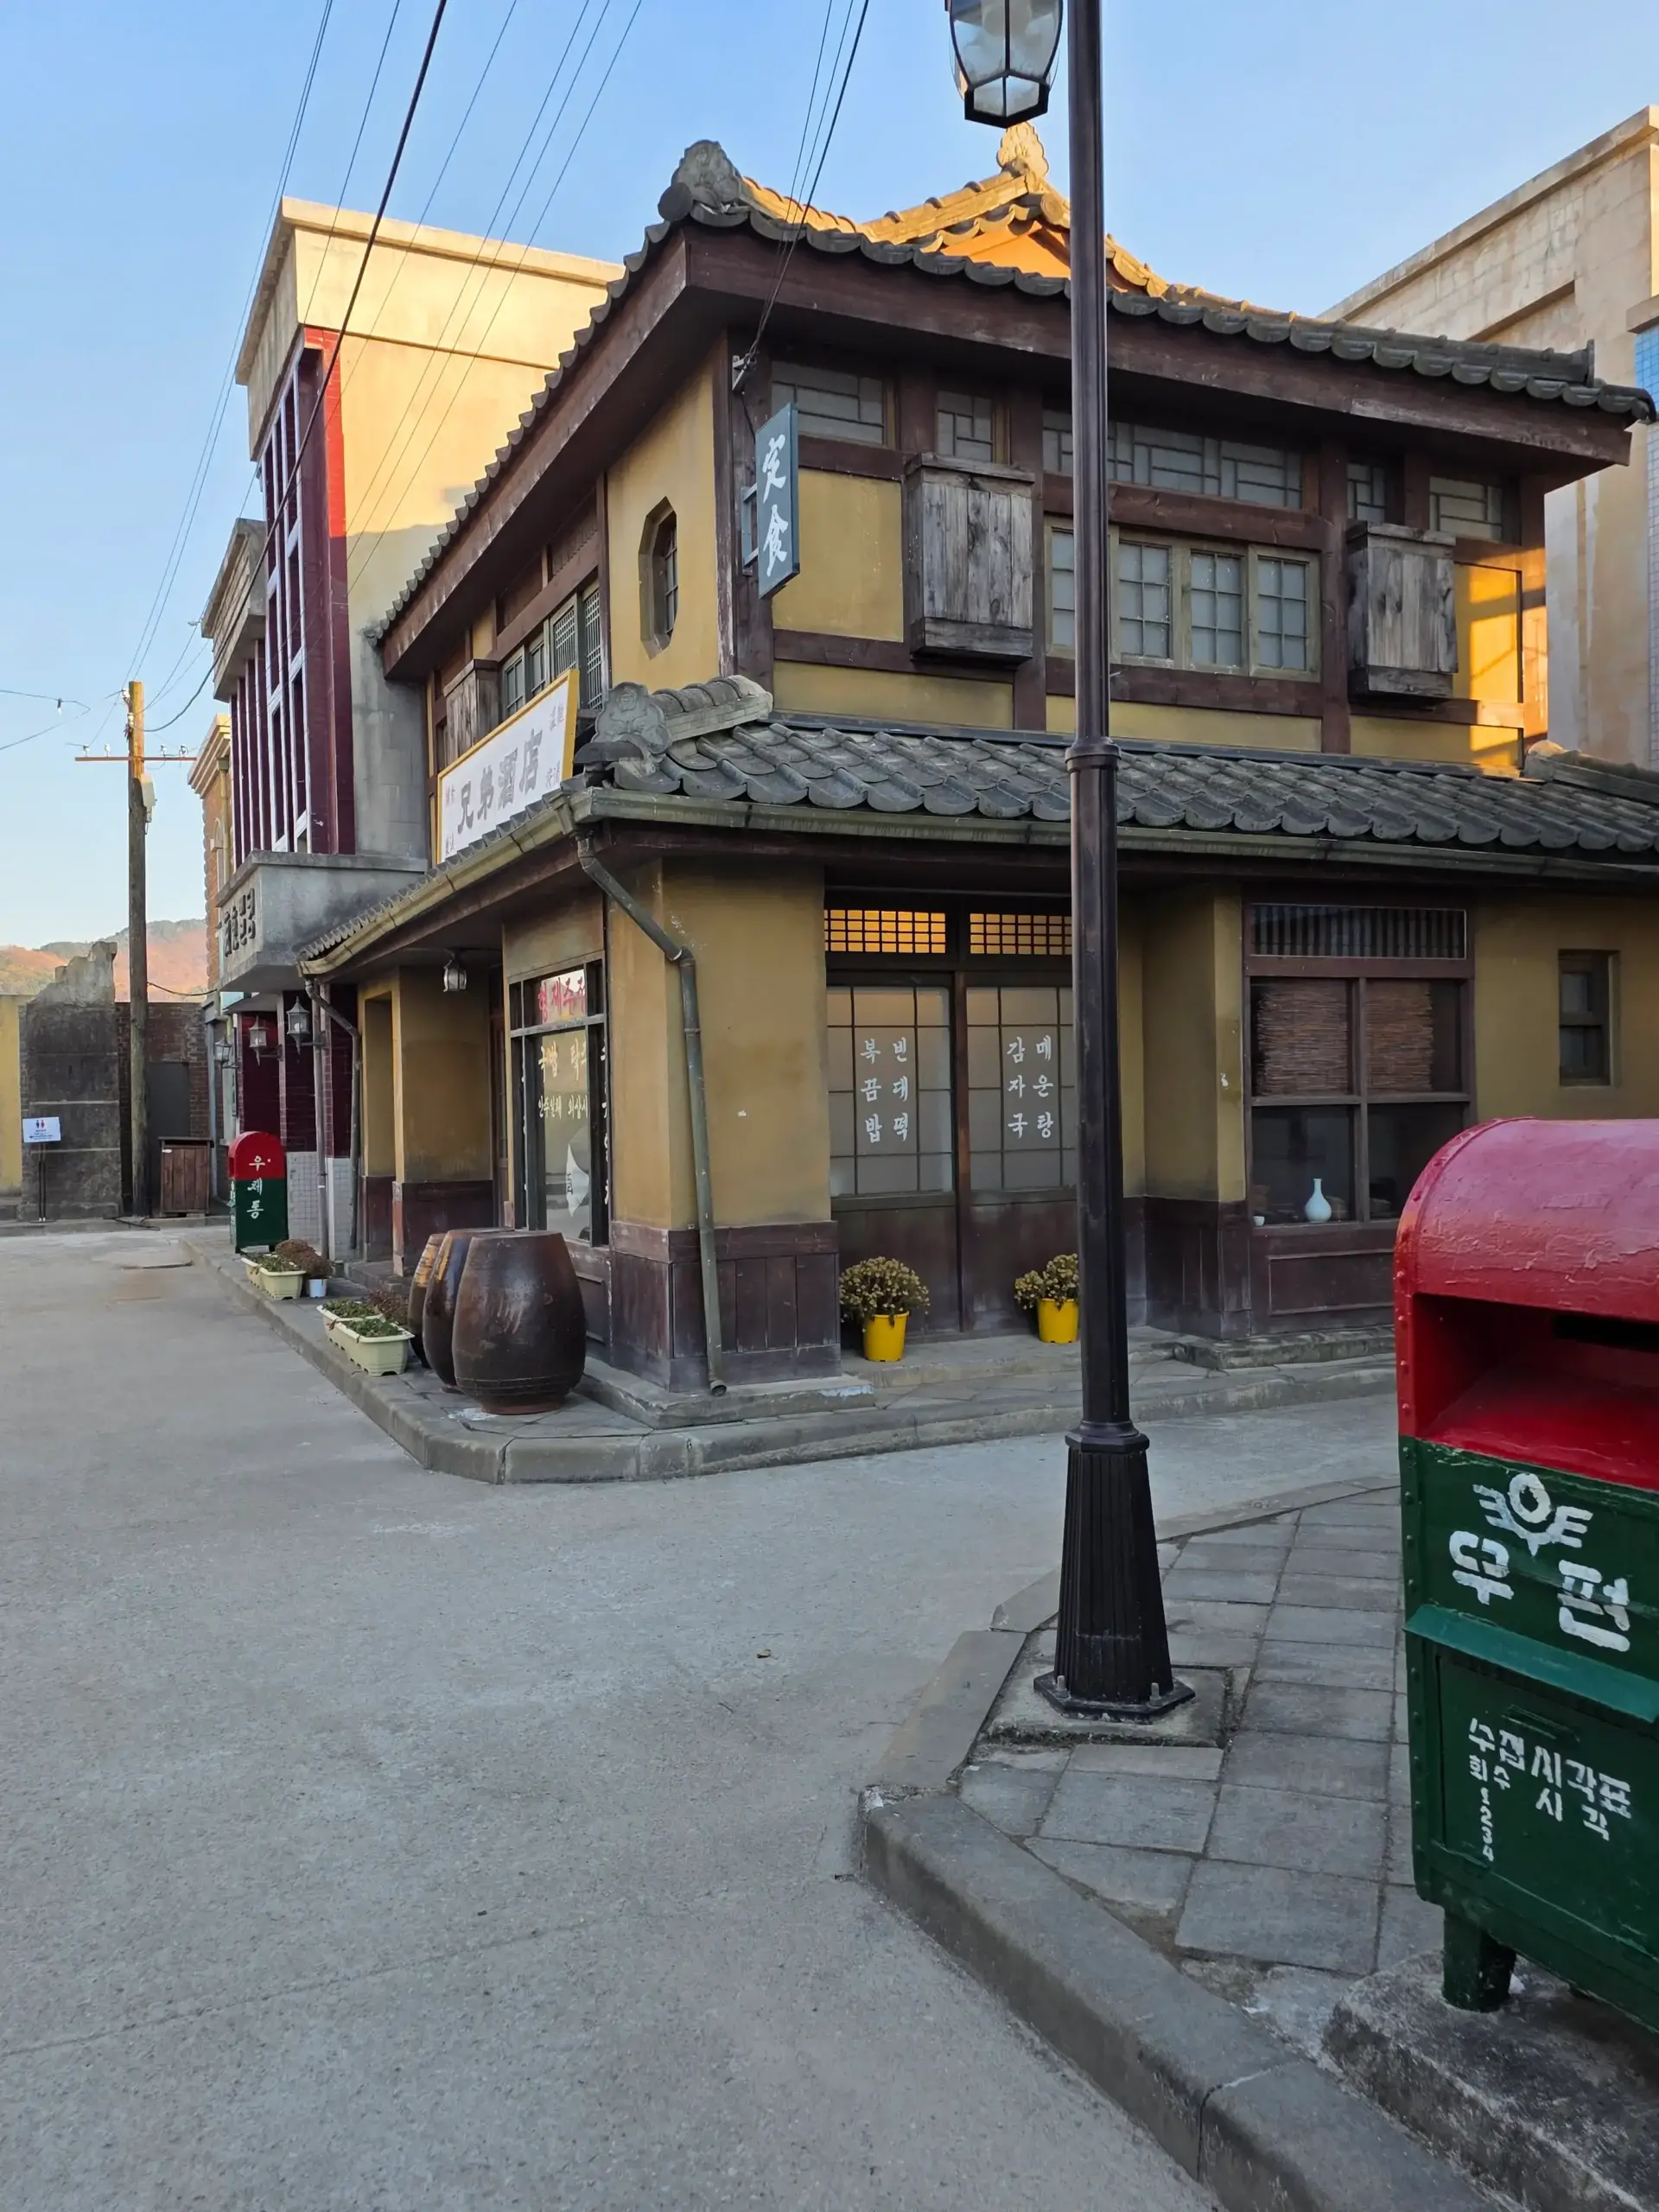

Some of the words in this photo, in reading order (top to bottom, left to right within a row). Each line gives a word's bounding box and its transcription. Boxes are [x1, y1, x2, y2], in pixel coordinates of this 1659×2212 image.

[457, 728, 543, 835] 兄弟酒店
[892, 1036, 909, 1142] 빈대떡
[1007, 1036, 1029, 1139] 감자국
[1449, 1529, 1631, 1652] 우편
